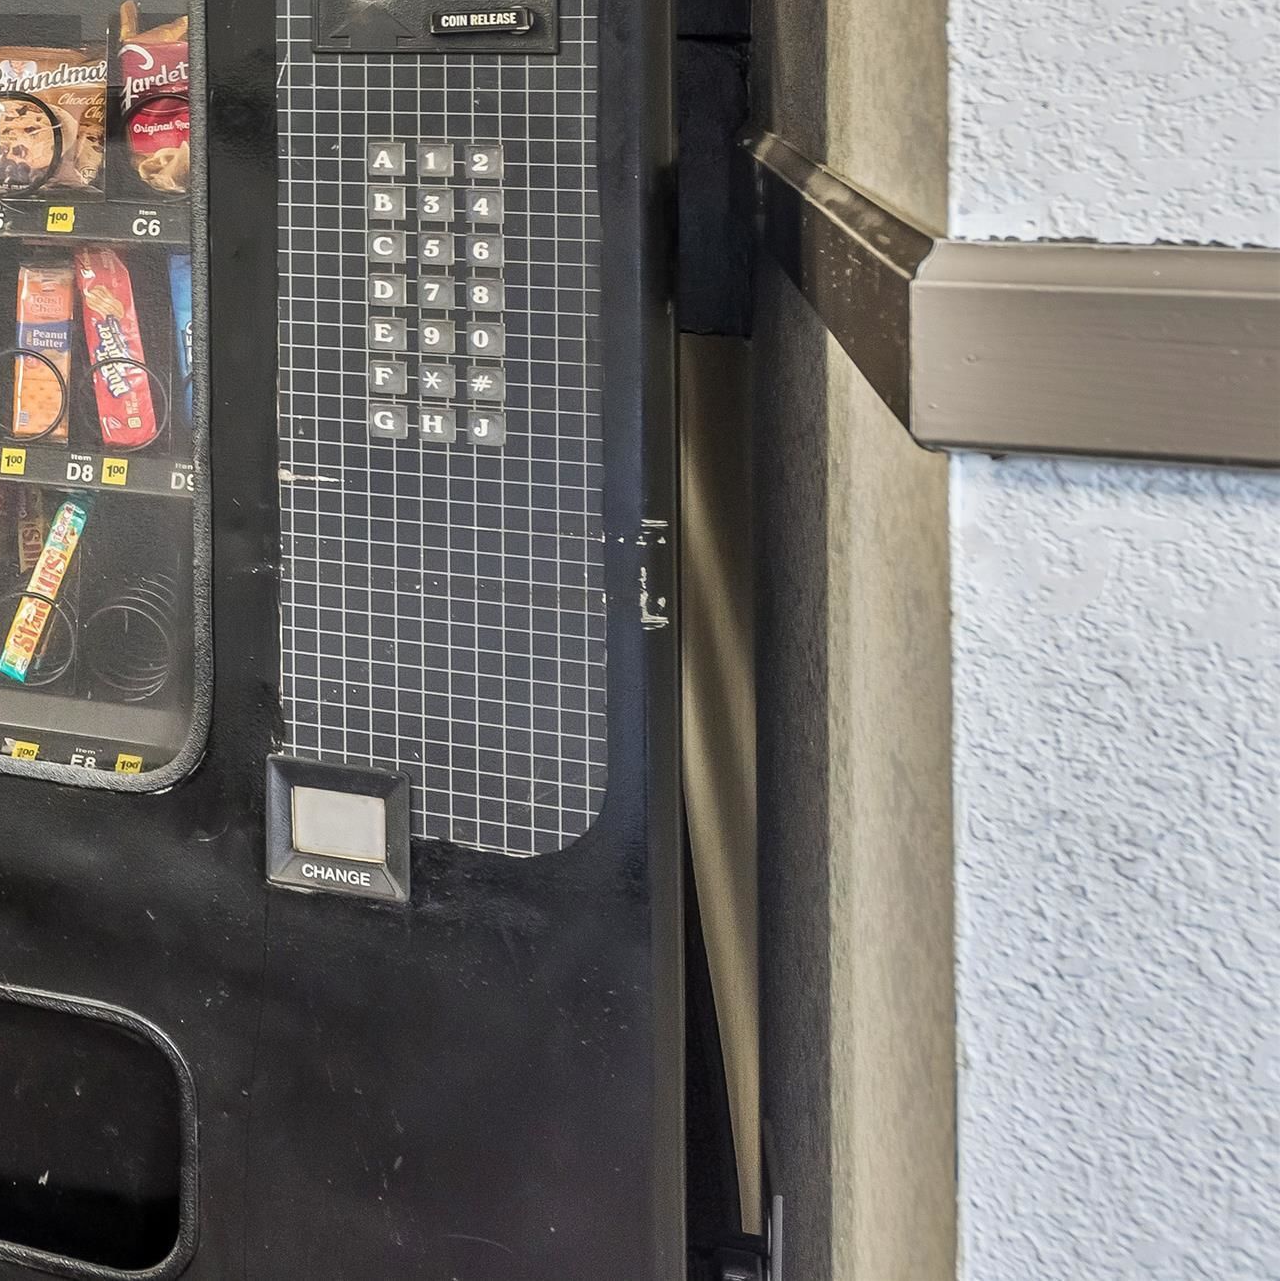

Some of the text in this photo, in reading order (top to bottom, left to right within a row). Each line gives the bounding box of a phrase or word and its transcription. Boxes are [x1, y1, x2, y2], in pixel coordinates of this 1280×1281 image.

[441, 12, 517, 27] COIN RELEASE
[133, 121, 173, 136] Original
[372, 151, 489, 172] A 1 2
[373, 193, 489, 215] B 3 4
[132, 218, 161, 236] C6
[32, 329, 67, 339] Peanut
[32, 338, 64, 348] Butter
[66, 462, 94, 482] D8
[301, 863, 371, 887] CHANGE
